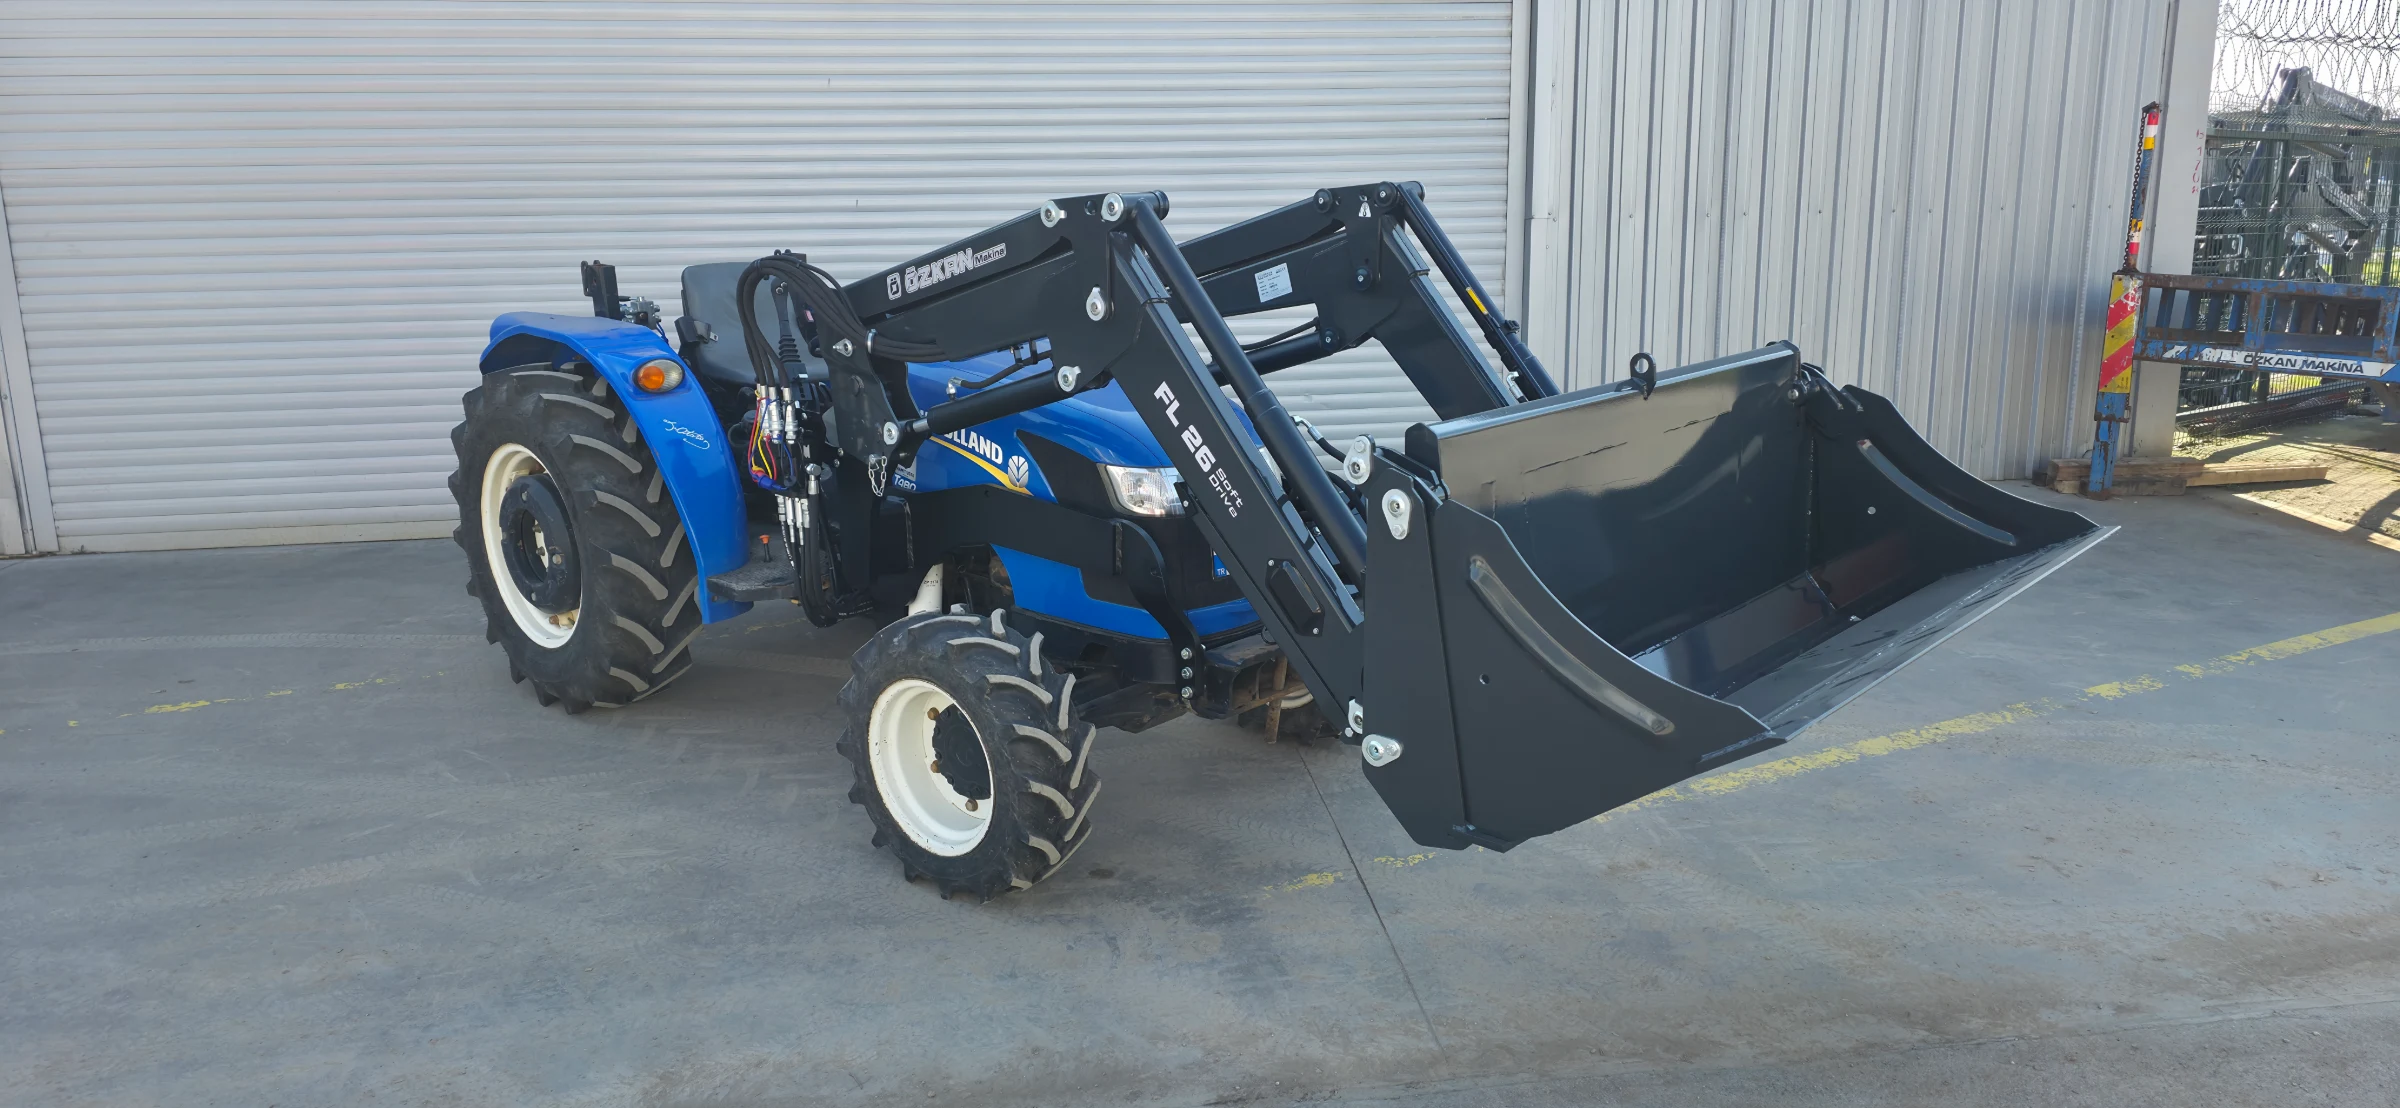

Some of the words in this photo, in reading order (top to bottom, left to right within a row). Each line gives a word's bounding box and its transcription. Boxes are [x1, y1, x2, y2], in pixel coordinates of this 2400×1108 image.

[905, 248, 973, 293] ÖZKAN
[974, 246, 1005, 266] Makina
[2243, 354, 2297, 368] ÖZKAN
[2300, 358, 2364, 374] MAKİNA
[944, 428, 1003, 465] LLAND
[1153, 381, 1180, 428] FL
[1180, 424, 1217, 473] 26
[1208, 474, 1238, 518] Drive
[1215, 467, 1244, 508] Soft
[1216, 567, 1226, 576] TR
